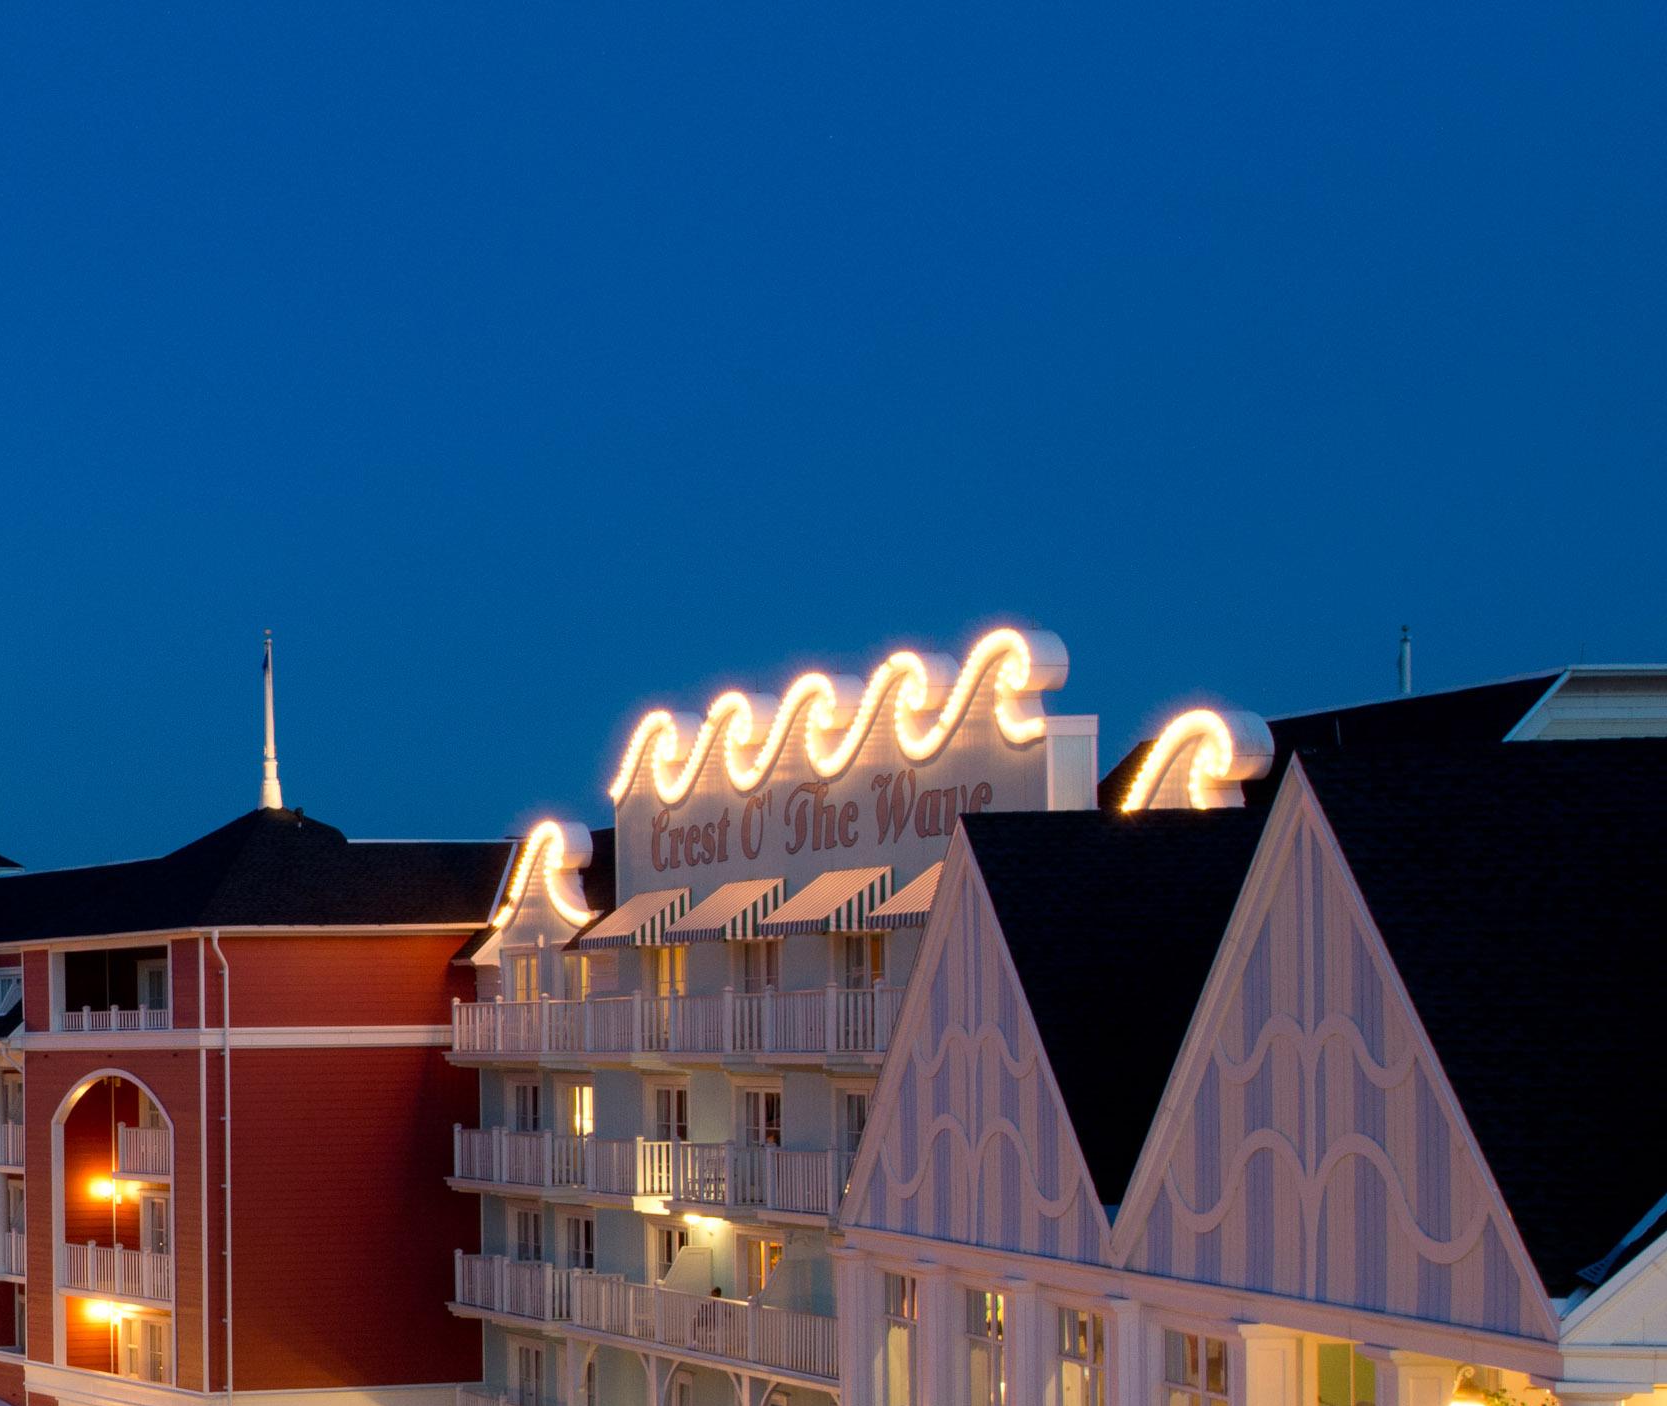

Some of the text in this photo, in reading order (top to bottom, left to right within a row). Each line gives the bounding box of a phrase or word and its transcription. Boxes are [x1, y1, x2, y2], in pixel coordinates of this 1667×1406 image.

[651, 807, 731, 872] Crest
[783, 780, 859, 855] The
[871, 768, 993, 845] Wave
